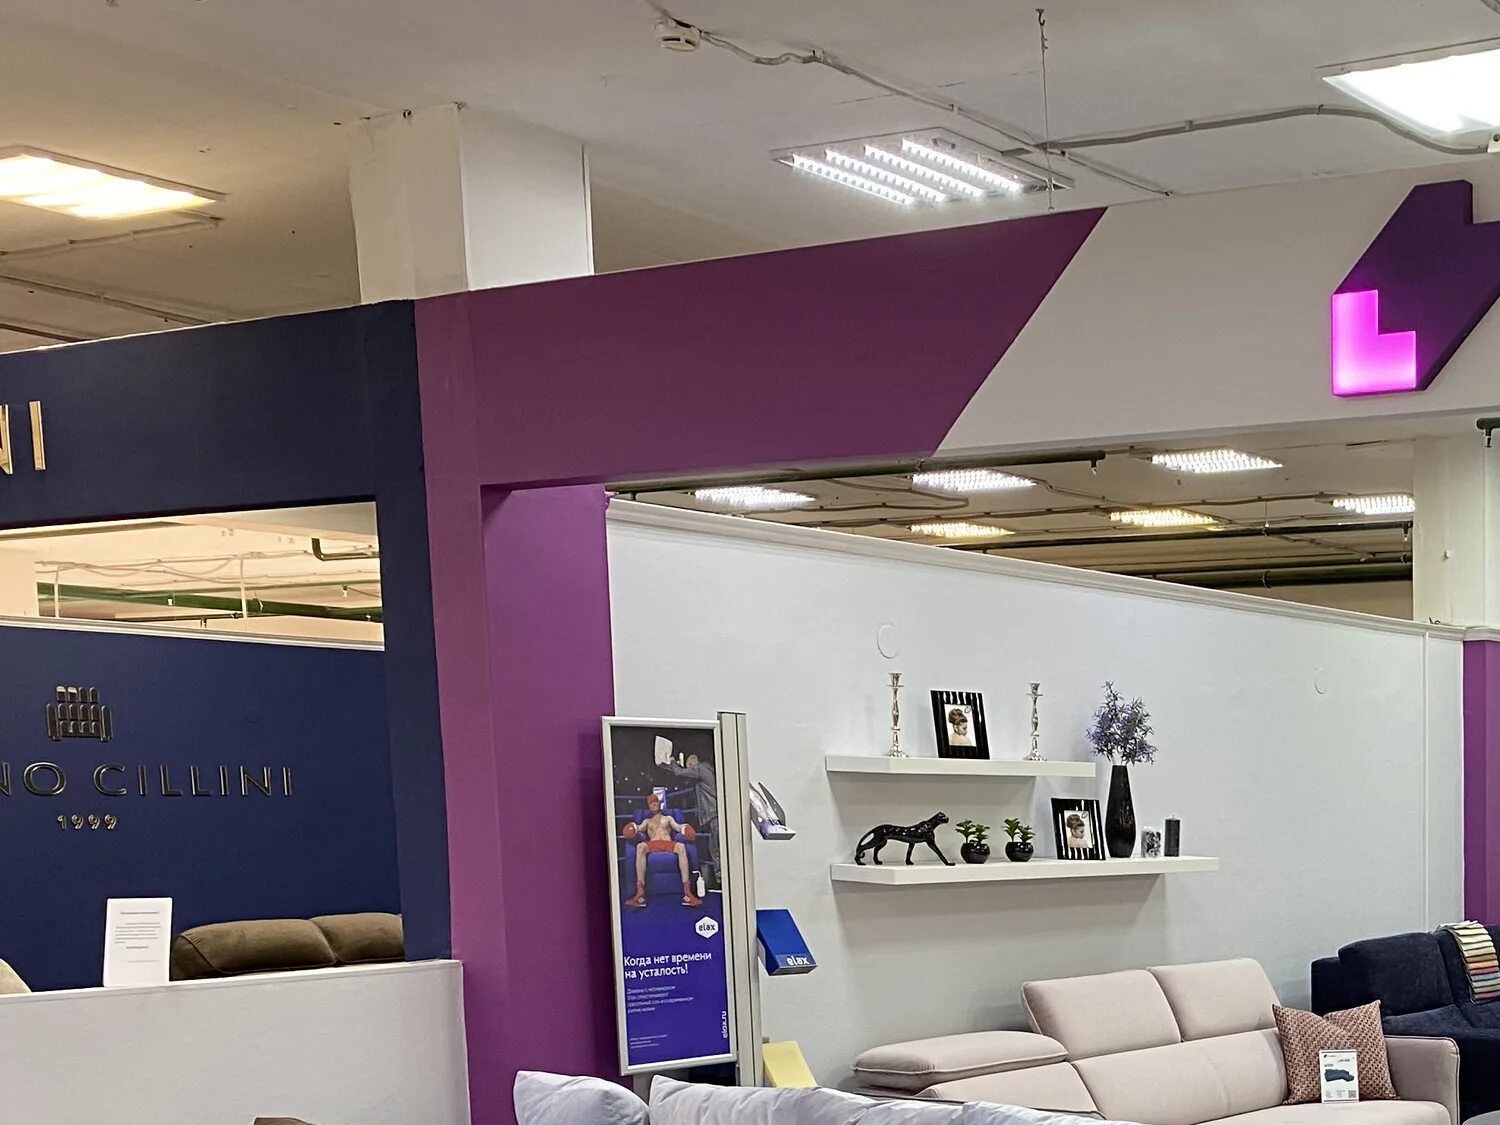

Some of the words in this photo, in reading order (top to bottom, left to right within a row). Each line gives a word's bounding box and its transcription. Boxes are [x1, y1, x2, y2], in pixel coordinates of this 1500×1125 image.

[92, 764, 293, 797] CILLINI
[57, 814, 118, 830] 1999
[698, 922, 716, 931] elax
[624, 956, 652, 967] Когда
[653, 955, 670, 964] нет
[671, 952, 712, 965] времени
[786, 955, 810, 966] elax
[625, 970, 637, 979] на
[639, 963, 689, 980] усталость!
